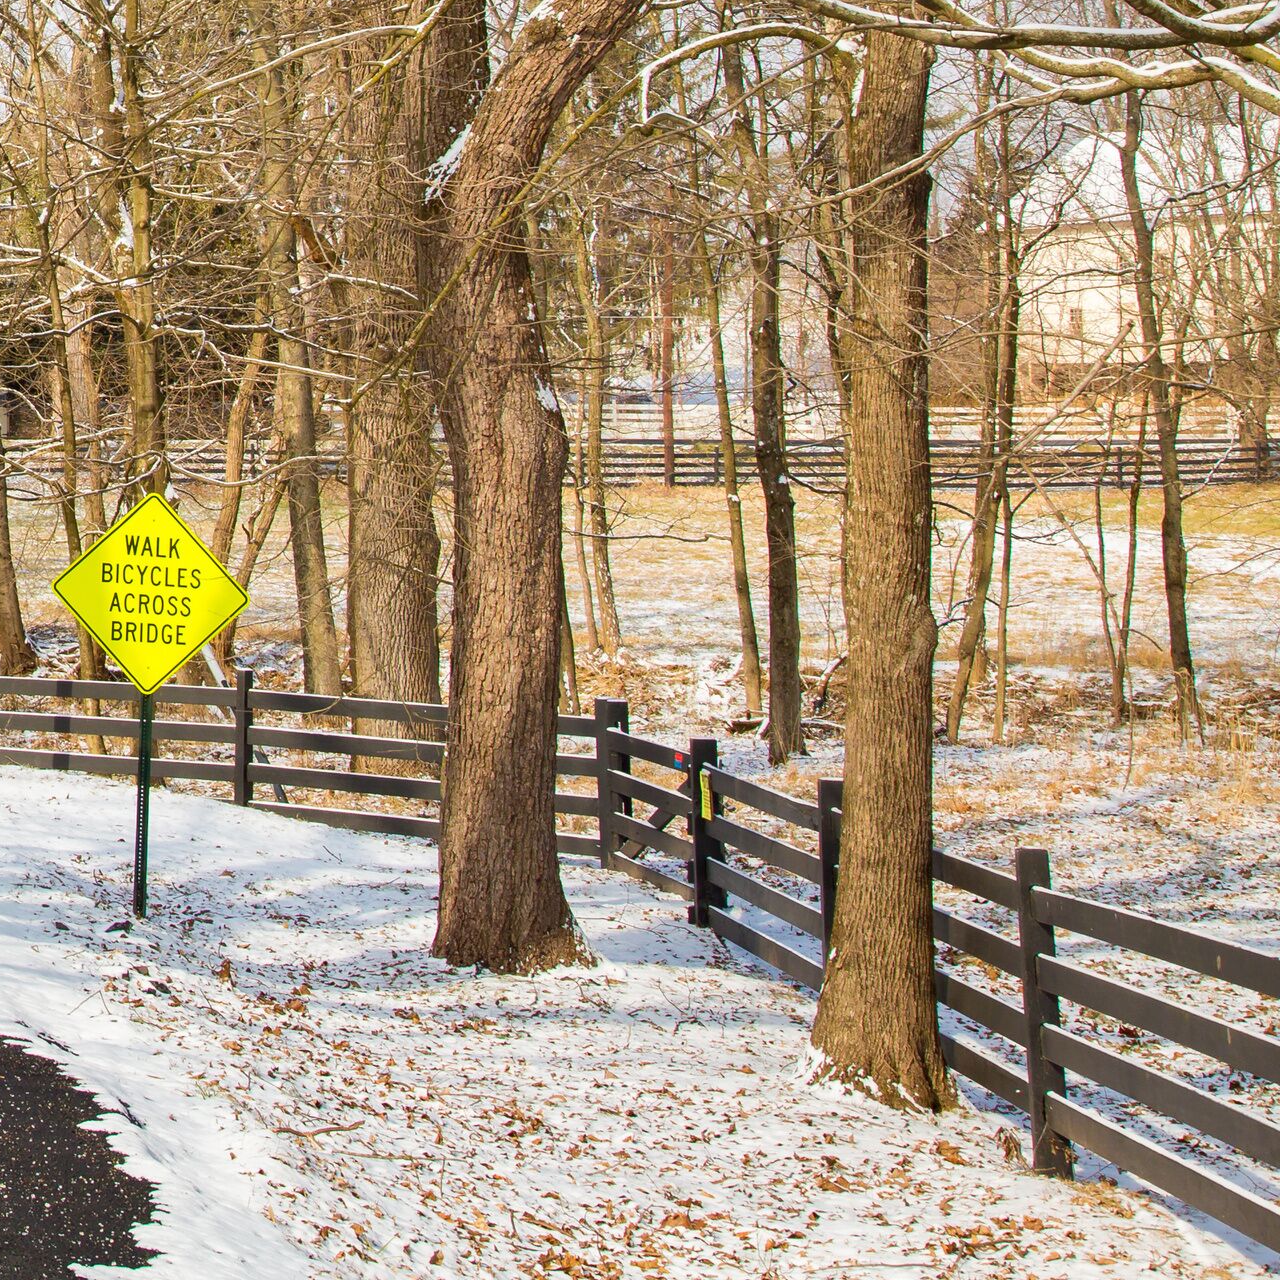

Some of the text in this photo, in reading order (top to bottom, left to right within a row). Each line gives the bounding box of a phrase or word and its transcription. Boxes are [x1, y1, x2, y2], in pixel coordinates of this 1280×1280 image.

[125, 534, 180, 559] WALK
[101, 562, 201, 589] BICYCLES
[109, 592, 191, 617] ACROSS
[111, 620, 186, 645] BRIDGE
